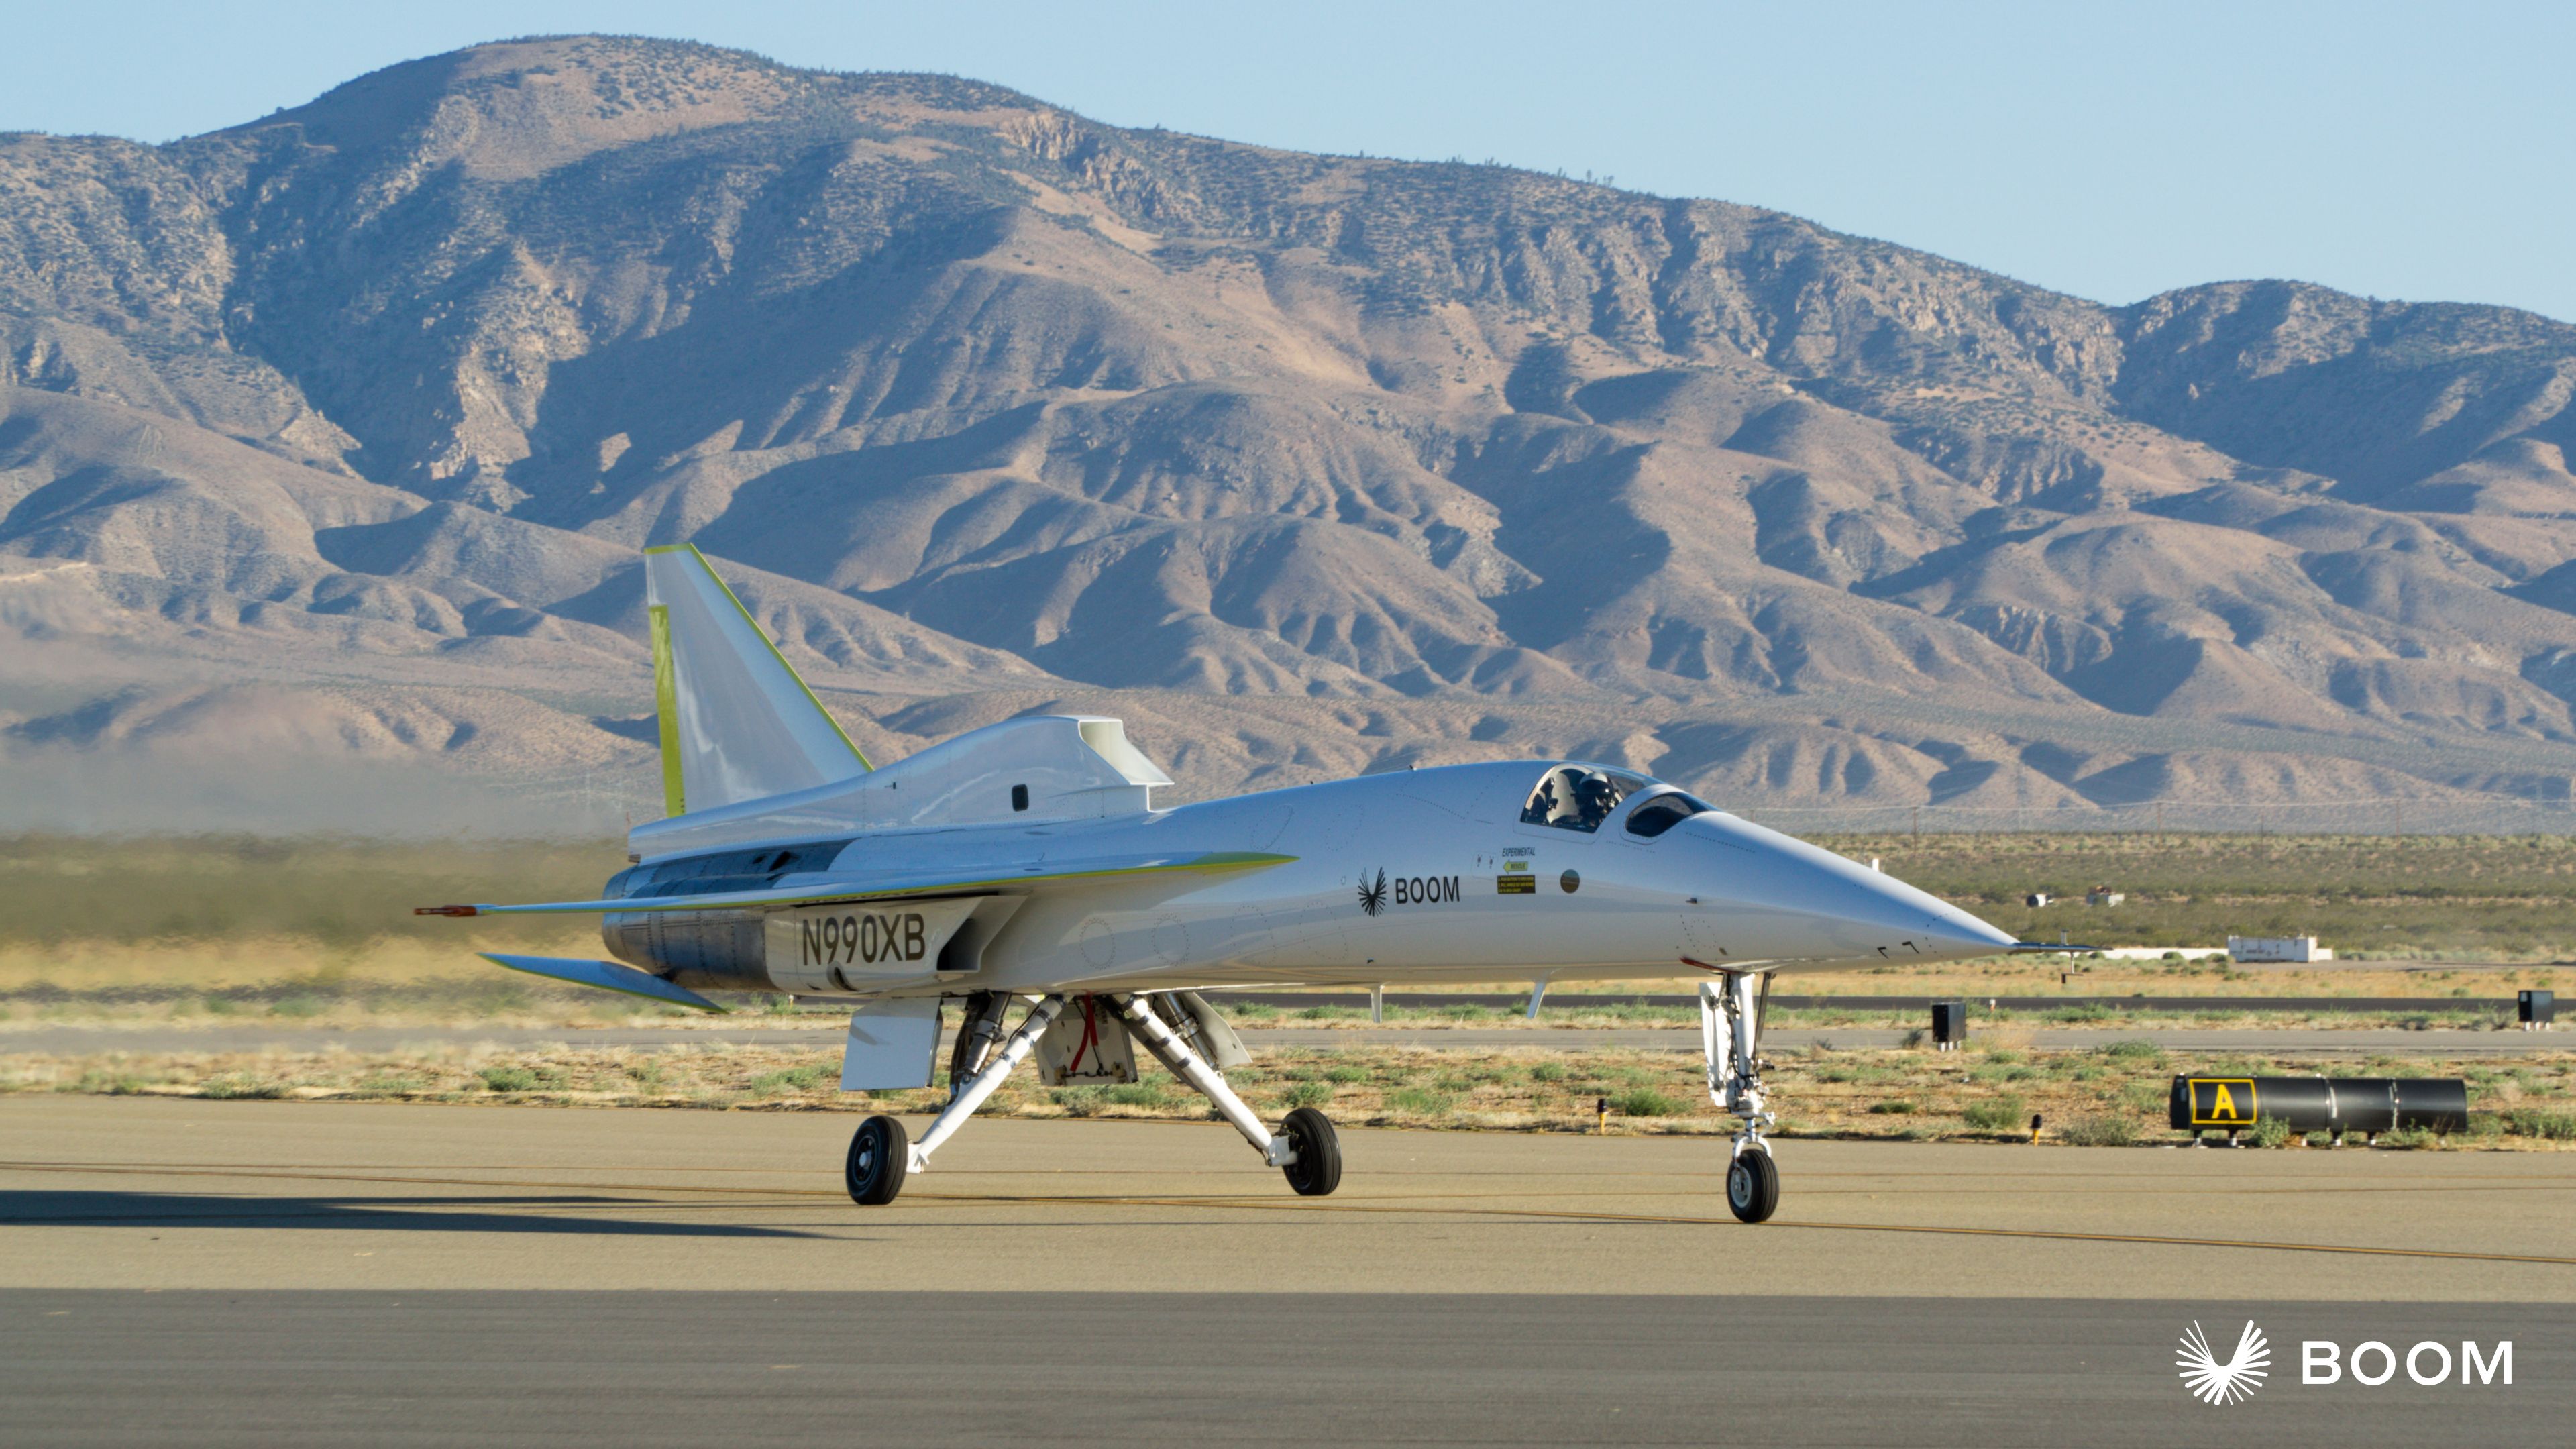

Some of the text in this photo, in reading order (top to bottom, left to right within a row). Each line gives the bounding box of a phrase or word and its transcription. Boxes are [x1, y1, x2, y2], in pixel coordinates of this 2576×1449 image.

[1502, 847, 1536, 857] EXPERIMENTAL
[1395, 875, 1460, 904] BOOM
[803, 913, 926, 966] N990XB
[2211, 1083, 2237, 1120] A
